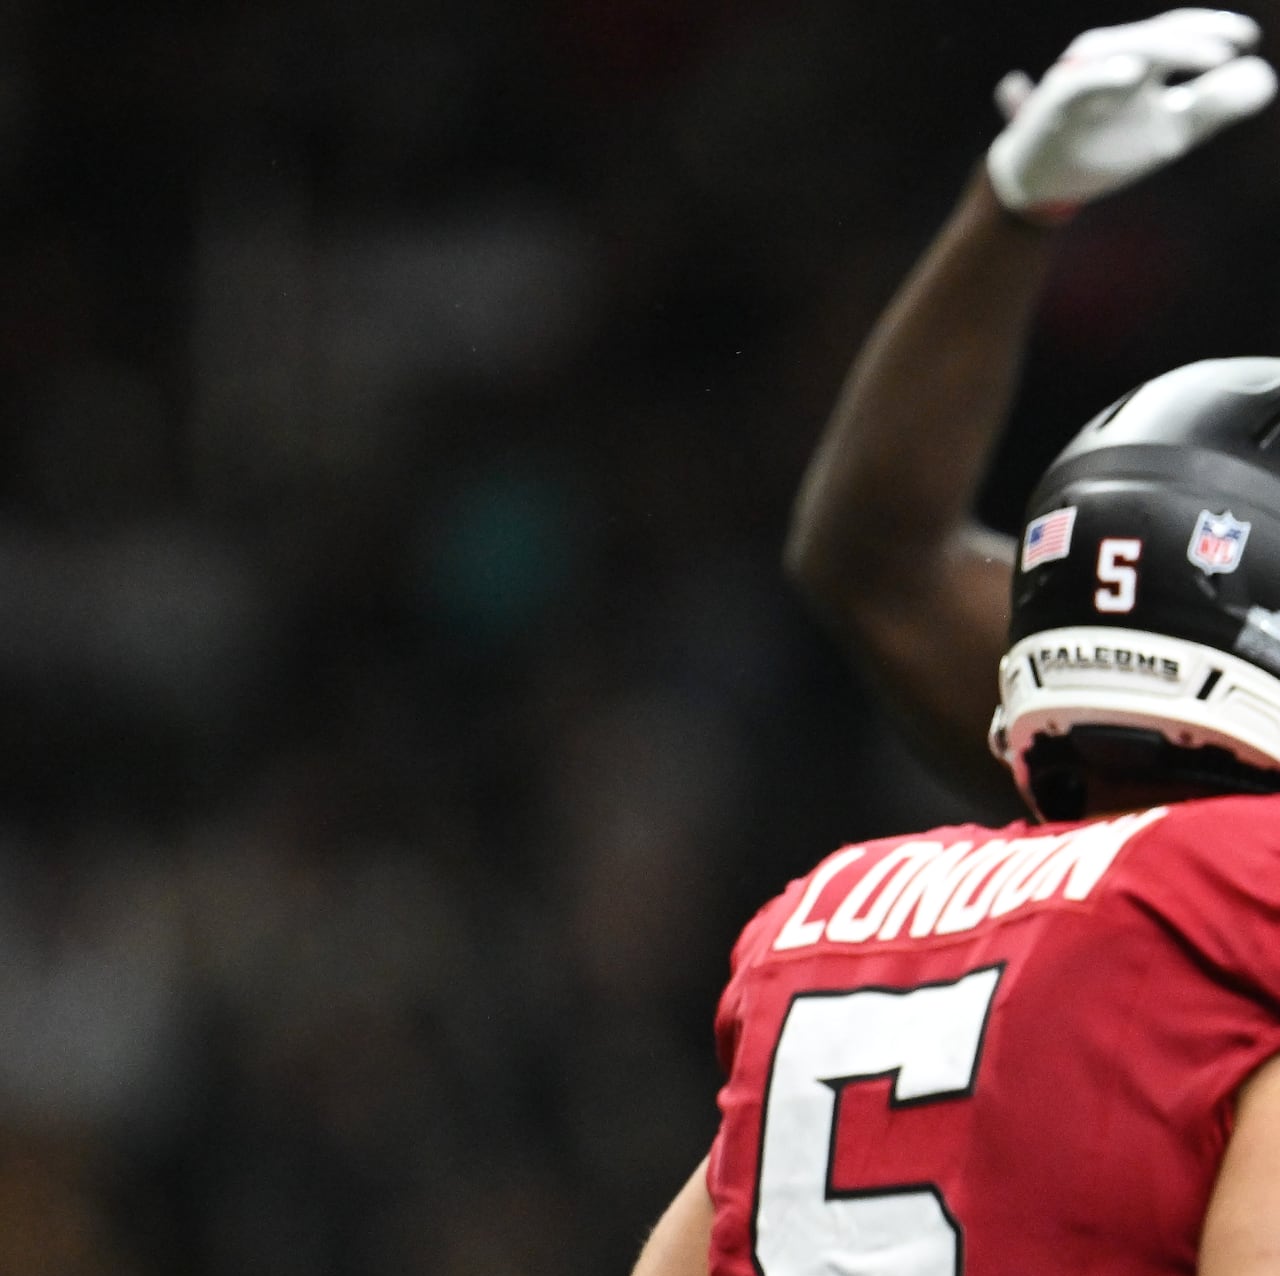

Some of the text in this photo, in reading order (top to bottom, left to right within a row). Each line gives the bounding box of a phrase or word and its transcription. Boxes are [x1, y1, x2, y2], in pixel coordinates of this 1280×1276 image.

[1094, 538, 1142, 613] 5
[1040, 645, 1181, 681] FALCONS
[772, 806, 1169, 952] LONDON
